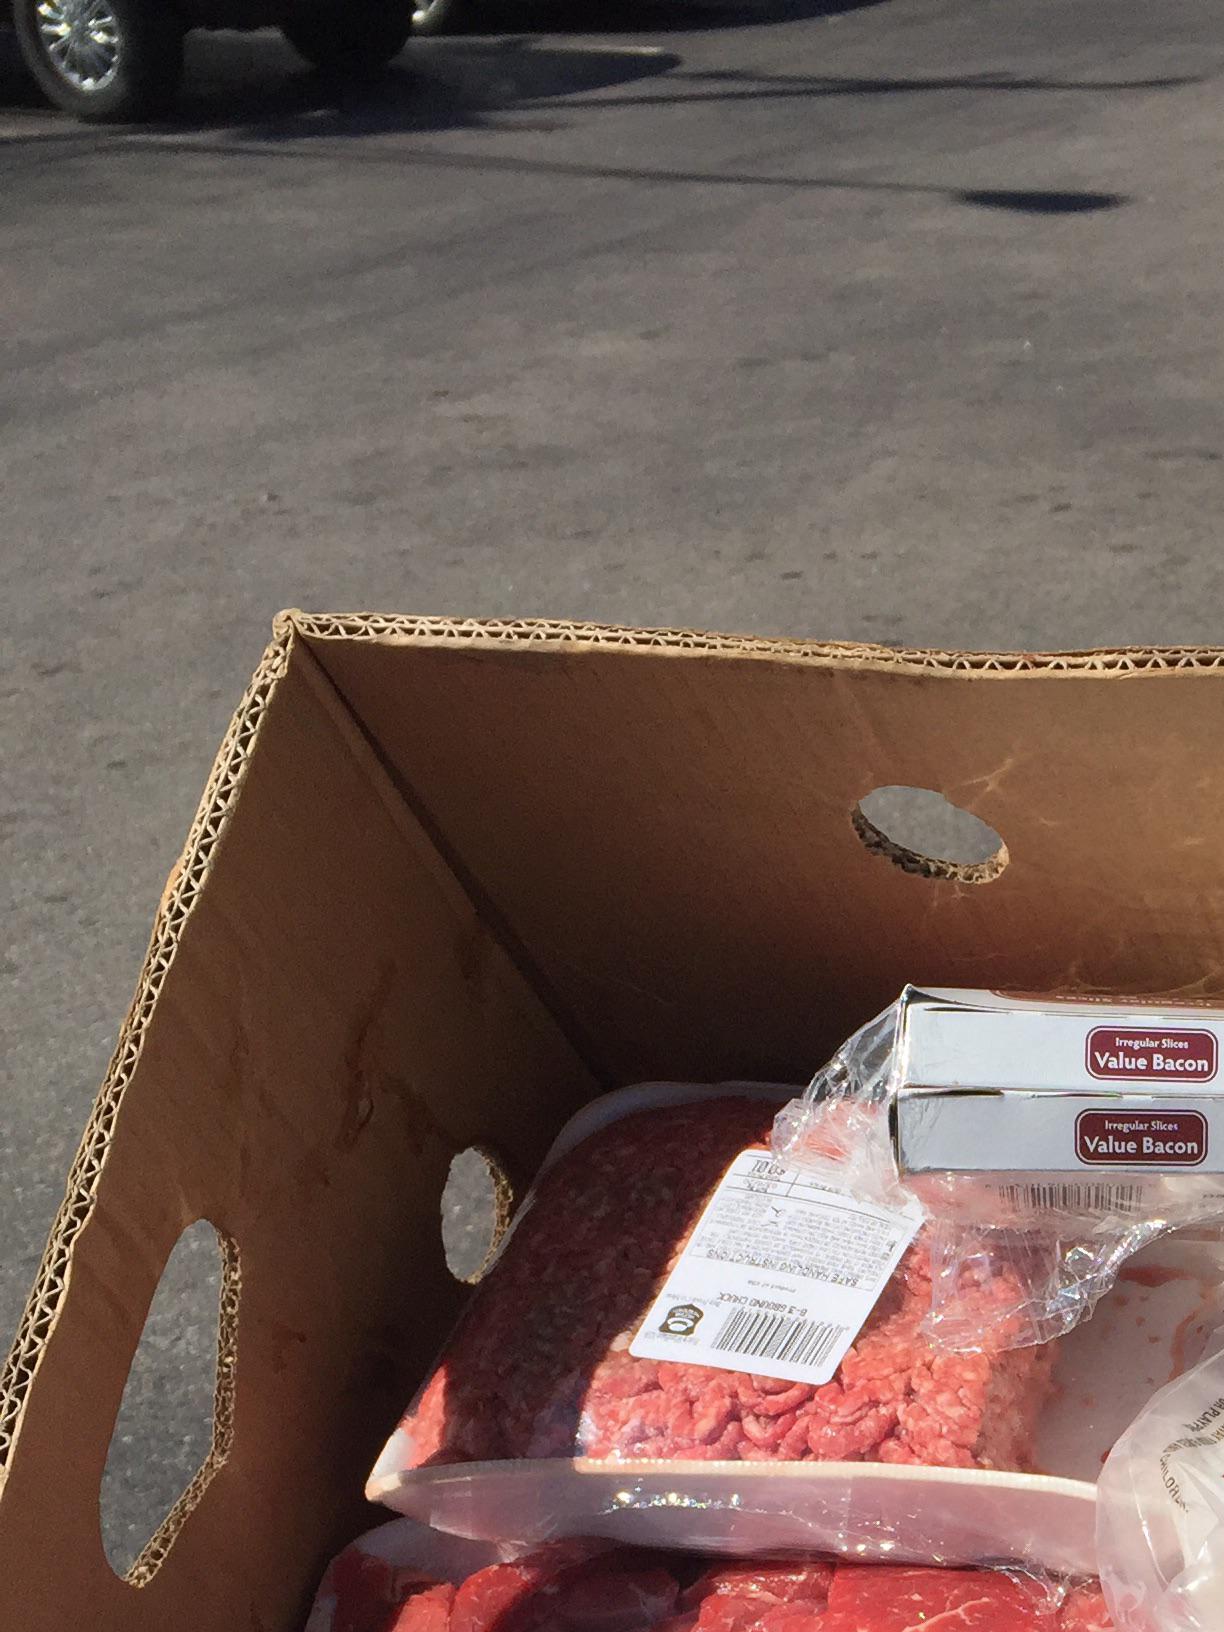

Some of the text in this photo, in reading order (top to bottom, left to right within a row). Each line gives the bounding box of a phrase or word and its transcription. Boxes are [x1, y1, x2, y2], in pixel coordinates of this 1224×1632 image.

[1115, 1037, 1189, 1050] Irregular Slices
[1094, 1052, 1209, 1071] Value Bacon
[1105, 1120, 1179, 1133] Irregular Slices
[1084, 1136, 1199, 1154] Value Bacon
